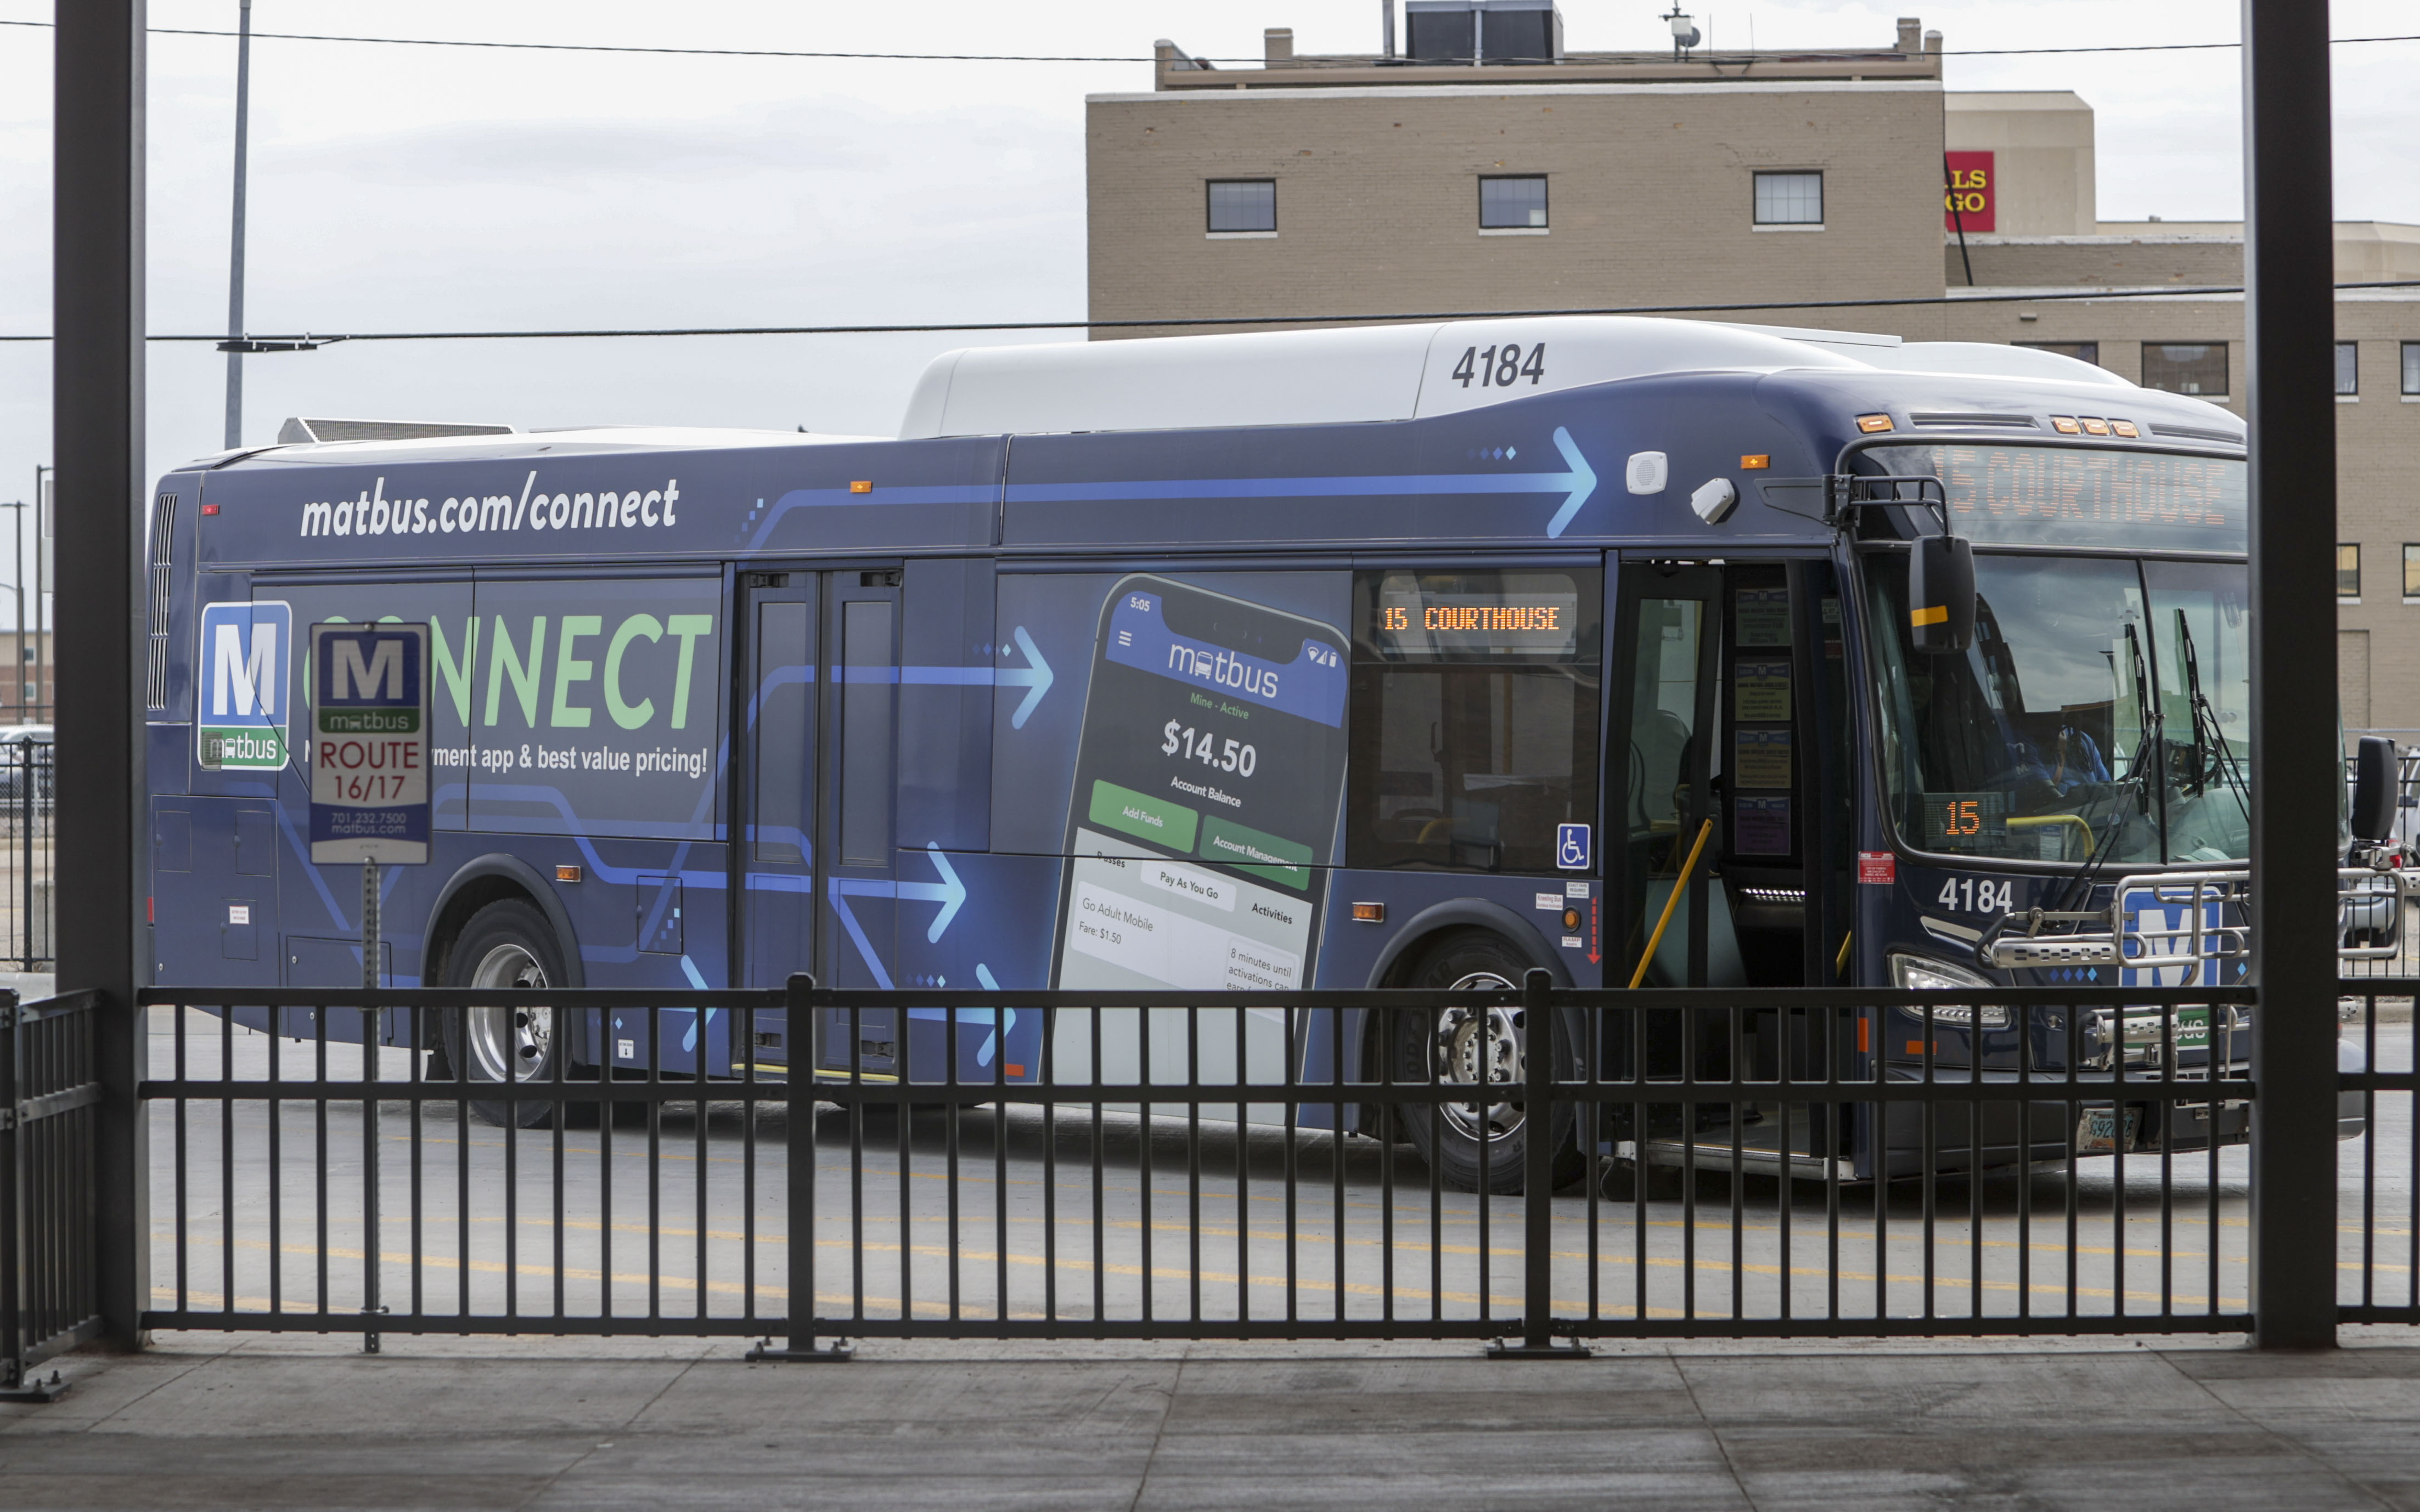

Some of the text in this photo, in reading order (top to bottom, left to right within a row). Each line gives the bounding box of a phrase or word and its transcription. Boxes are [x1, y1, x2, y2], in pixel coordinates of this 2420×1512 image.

[1452, 343, 1545, 388] 4184
[301, 470, 679, 537] matbus.com/connect
[1987, 452, 2225, 524] COURTHOUSE
[1130, 596, 1150, 612] 5:05
[1385, 607, 1560, 630] 15 COURTHOUSE
[213, 623, 277, 715] M
[303, 613, 713, 730] NNECT
[332, 639, 403, 700] M
[1168, 644, 1279, 699] matbus
[330, 712, 409, 730] matbus
[1190, 692, 1213, 709] Mine
[1220, 702, 1250, 720] Active
[320, 741, 419, 769] ROUTE
[432, 744, 707, 778] ment app & best value pricing!
[1161, 719, 1257, 777] $14.50
[335, 775, 406, 802] 16/17
[1170, 776, 1241, 808] Account Balance
[331, 813, 407, 824] 701.232.7500
[331, 823, 406, 834] matbus.com
[1123, 806, 1163, 827] Add Funds
[1946, 801, 1980, 835] 15
[1213, 836, 1298, 872] Account Management
[1160, 871, 1219, 900] Pay As You Go
[1939, 877, 2013, 913] 4184
[1082, 898, 1153, 932] Go Adult Mobile
[1252, 902, 1293, 924] Activities
[1079, 921, 1121, 945] Fare: $1.50
[1229, 967, 1272, 988] activations
[1231, 948, 1292, 978] 8 minutes until
